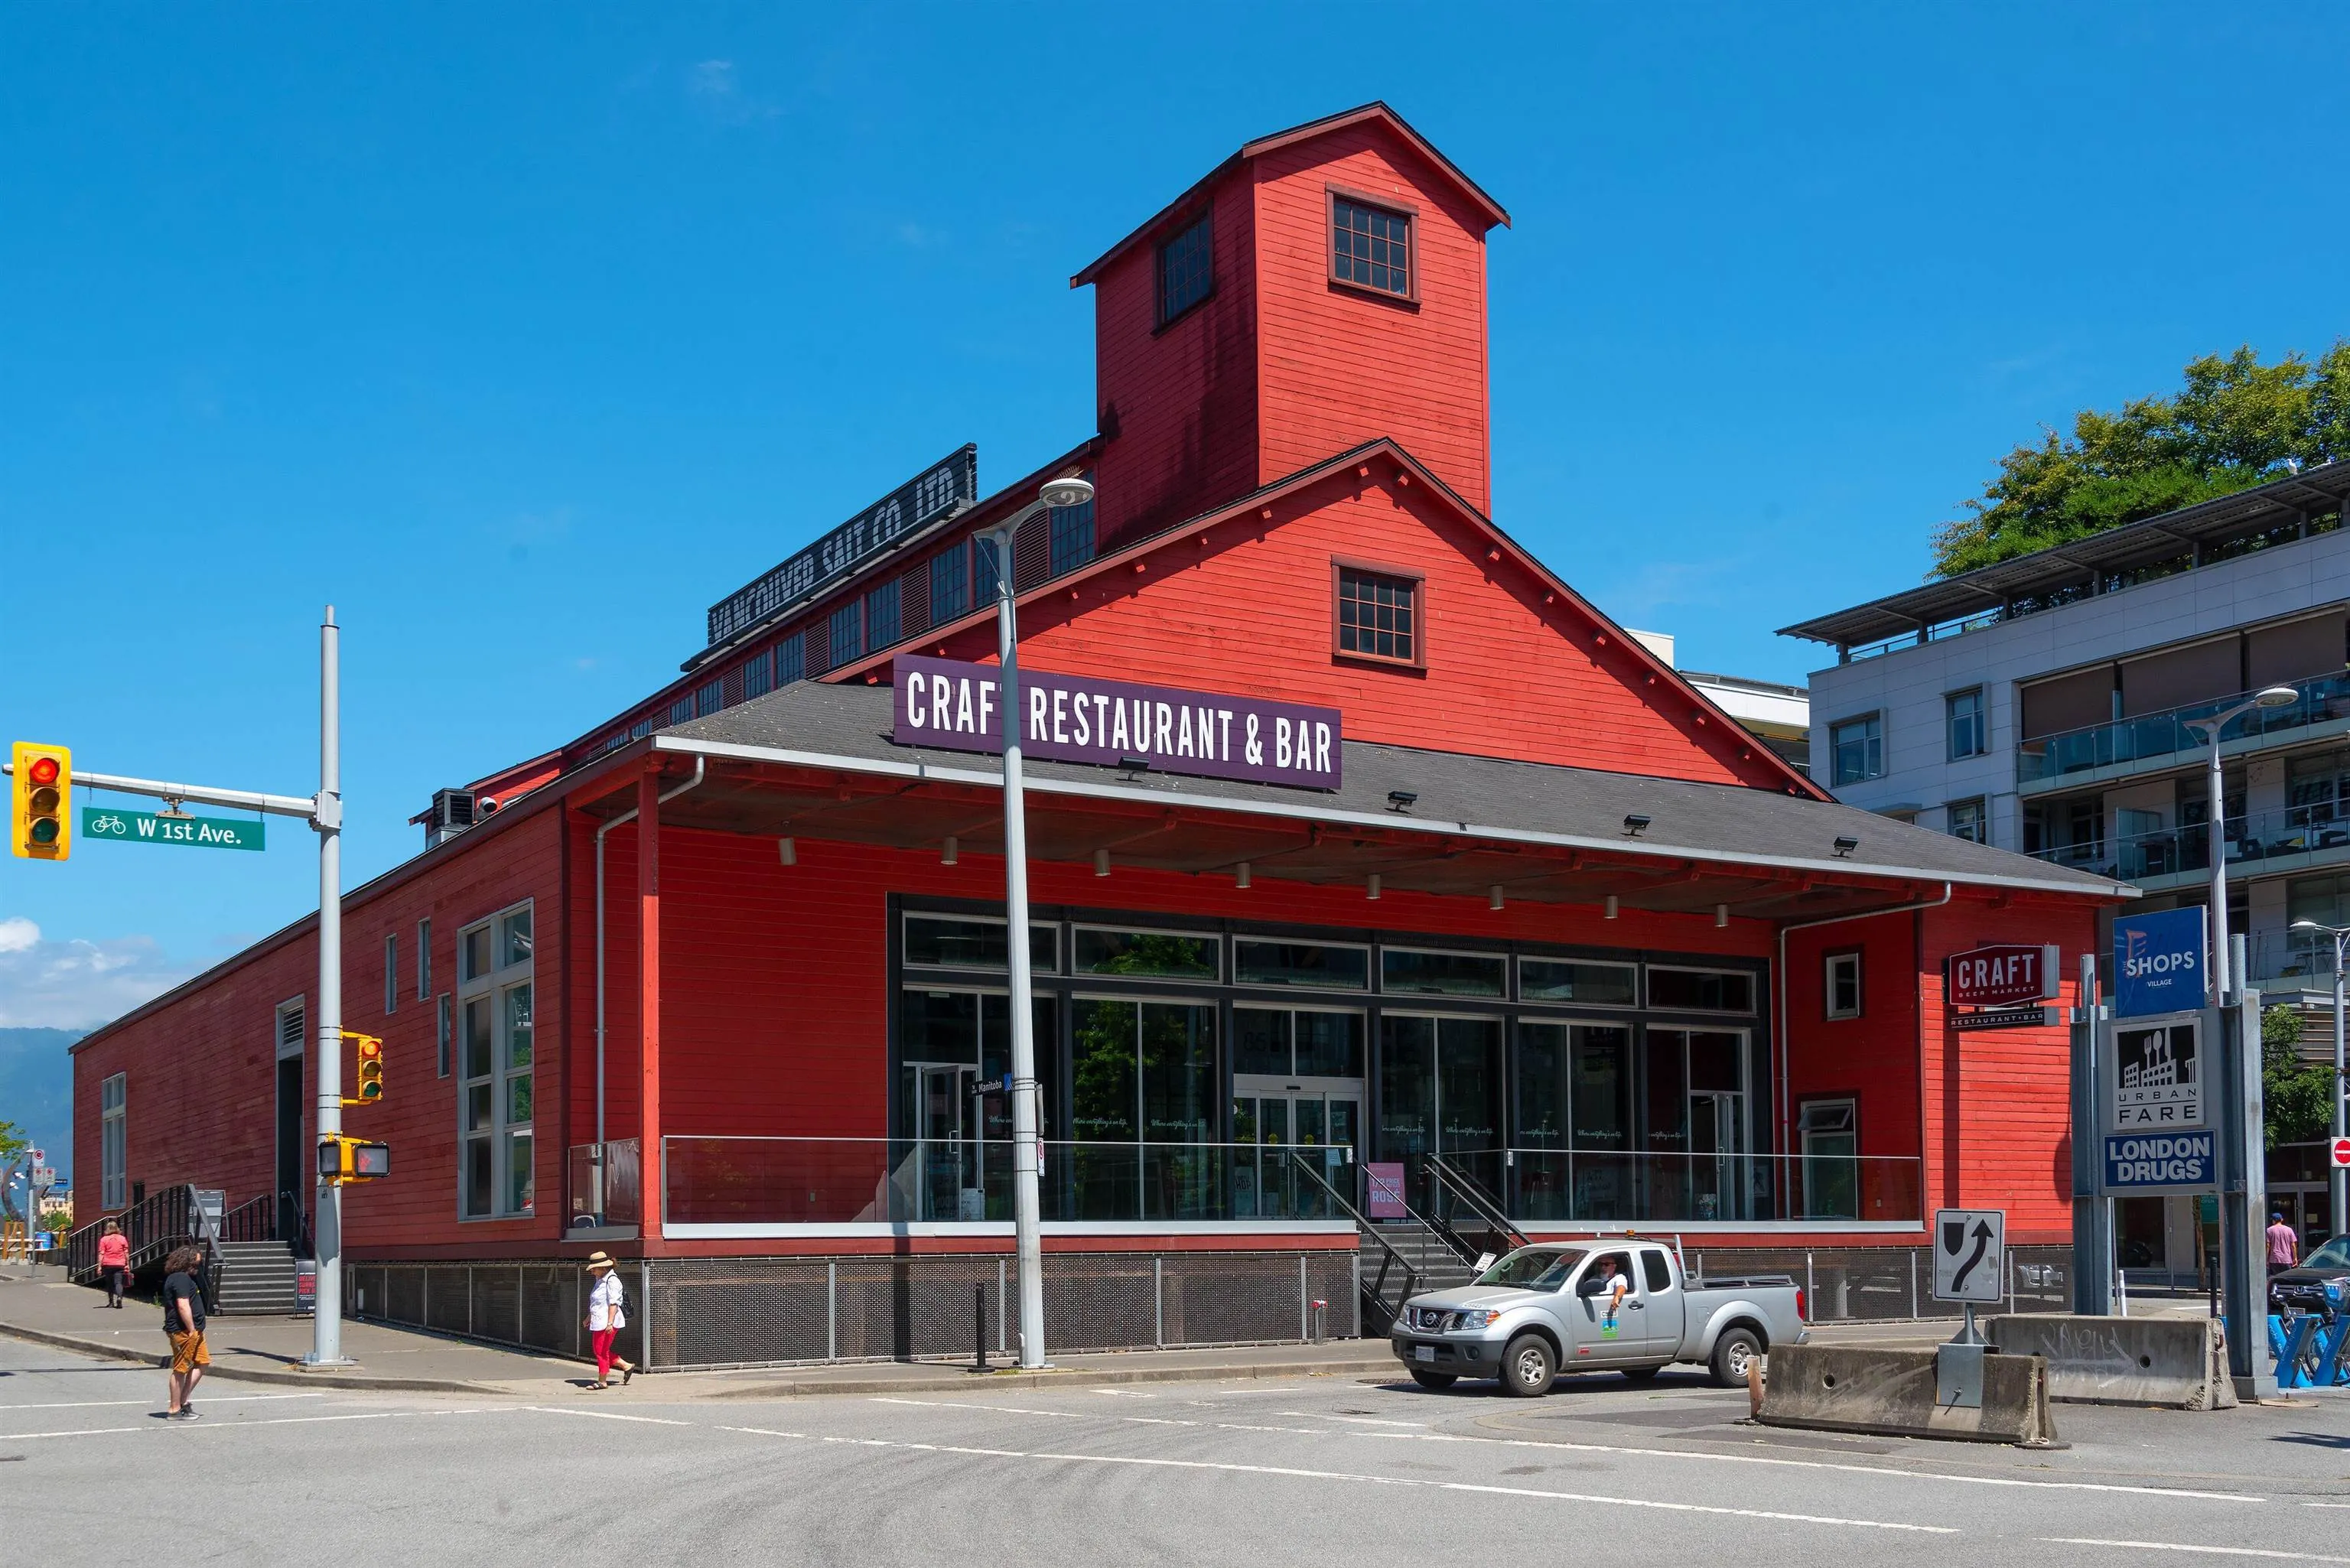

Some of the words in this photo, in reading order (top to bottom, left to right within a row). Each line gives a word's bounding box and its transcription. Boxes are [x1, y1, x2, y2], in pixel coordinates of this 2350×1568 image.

[908, 672, 1001, 734] CRAF
[1030, 686, 1232, 761] RESTAURANT
[1245, 713, 1262, 765] &
[1276, 717, 1331, 773] BAR
[137, 818, 156, 837] W
[162, 822, 194, 840] 1st
[198, 824, 242, 844] Ave.
[1958, 954, 2034, 989] CRAFT
[2127, 951, 2195, 976] SHOPS
[1992, 986, 2035, 994] MARKET
[2147, 978, 2173, 987] VILLAGE
[979, 1080, 1002, 1093] Manitoba
[2119, 1088, 2196, 1101] URBAN
[2119, 1105, 2196, 1123] FARE
[2109, 1137, 2210, 1160] LONDON
